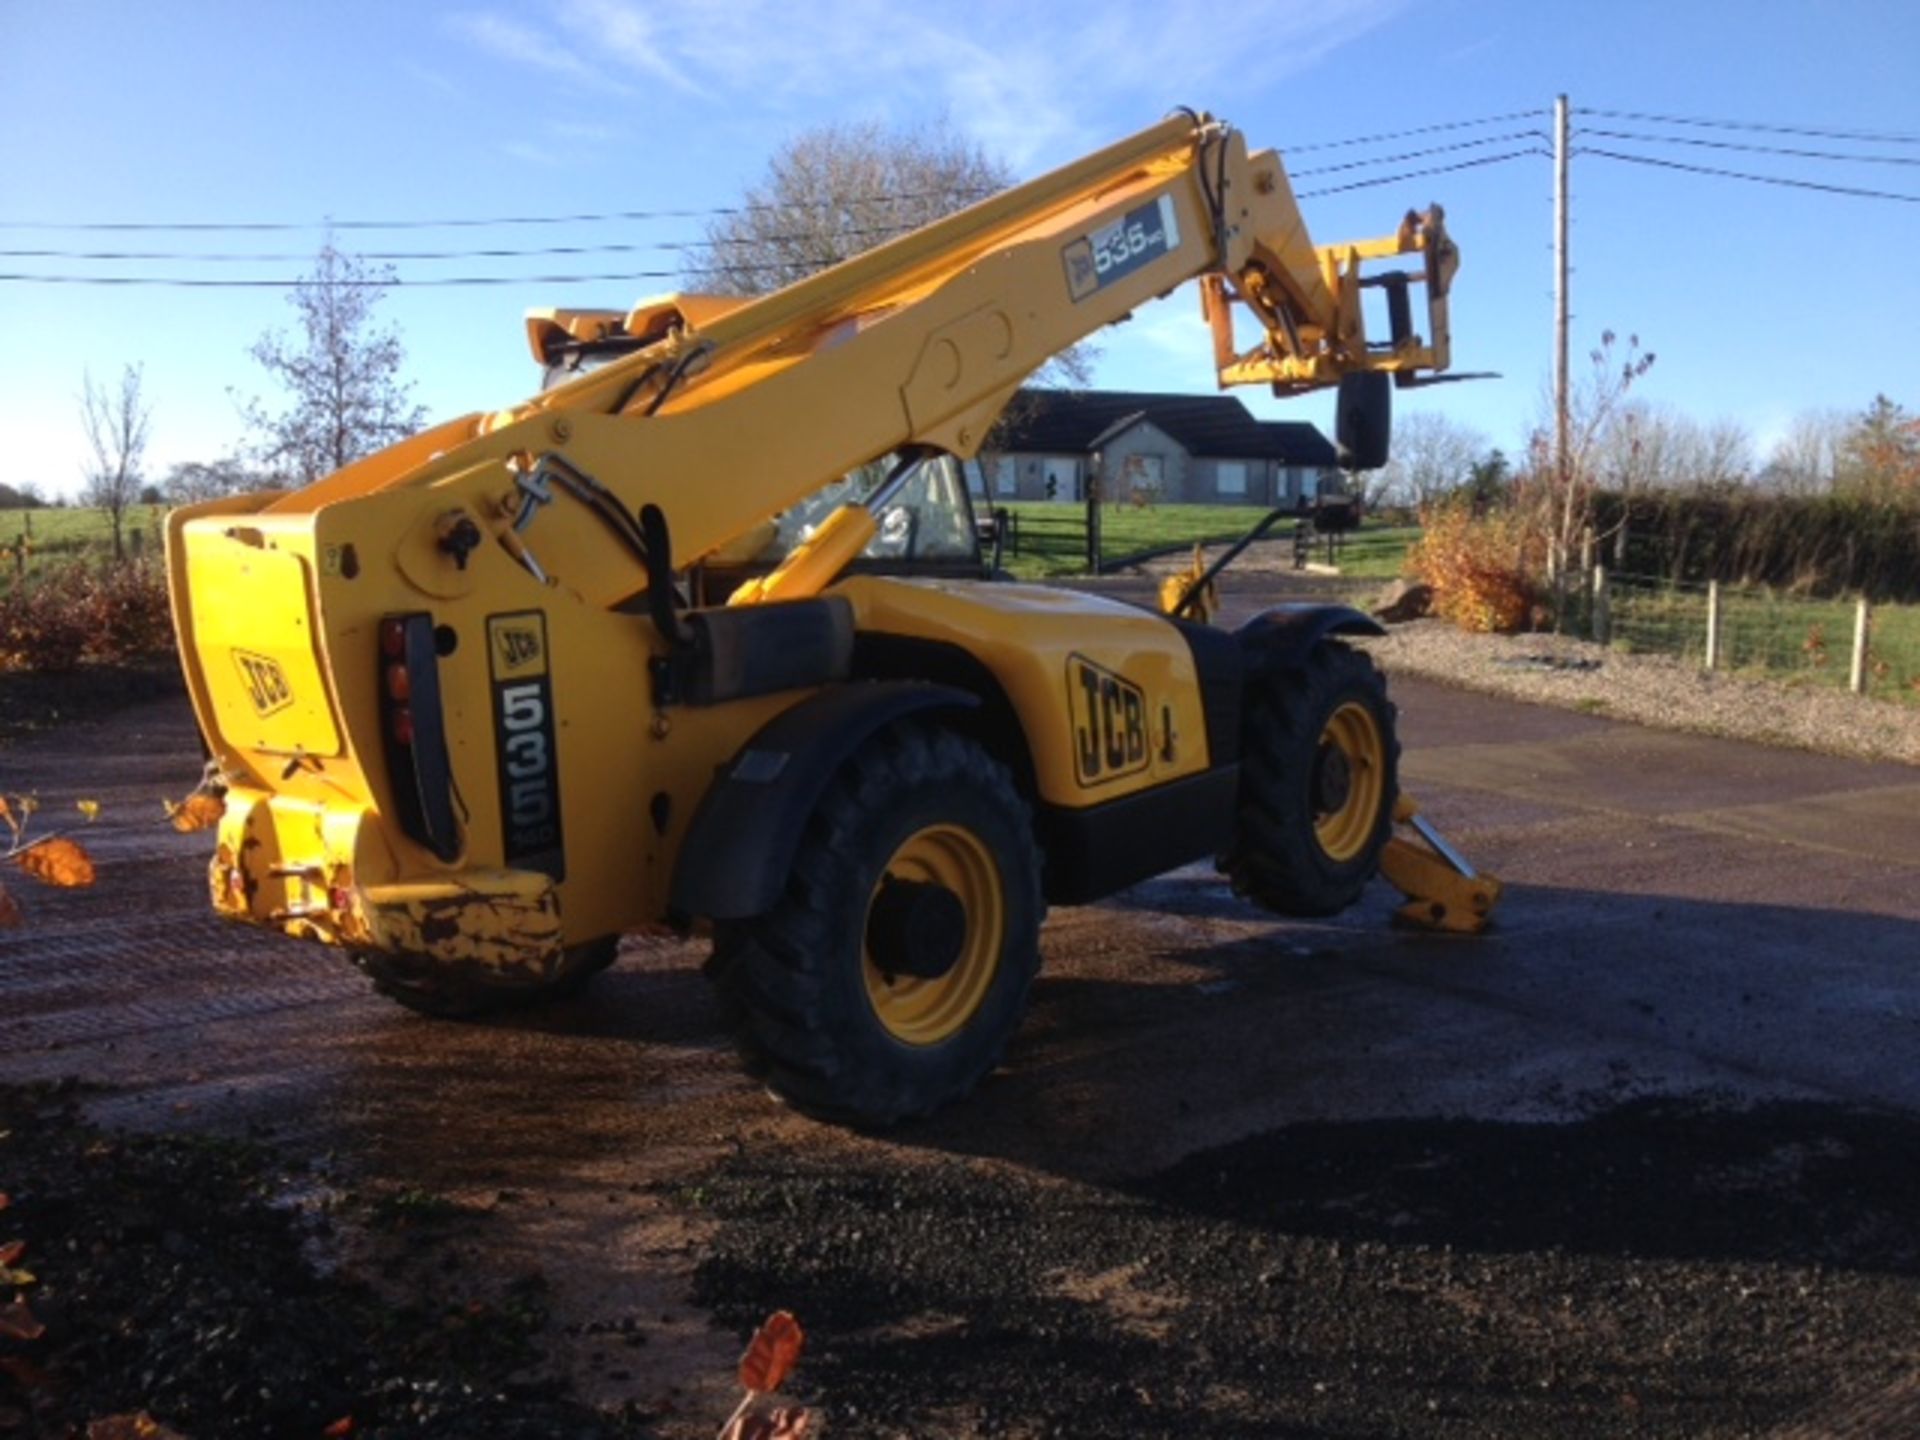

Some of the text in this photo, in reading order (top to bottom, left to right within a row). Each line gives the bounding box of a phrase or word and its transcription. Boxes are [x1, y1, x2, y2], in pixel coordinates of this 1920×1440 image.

[1094, 221, 1147, 274] 535
[240, 656, 289, 710] JCB
[1078, 662, 1144, 777] JCB
[503, 683, 551, 826] 535
